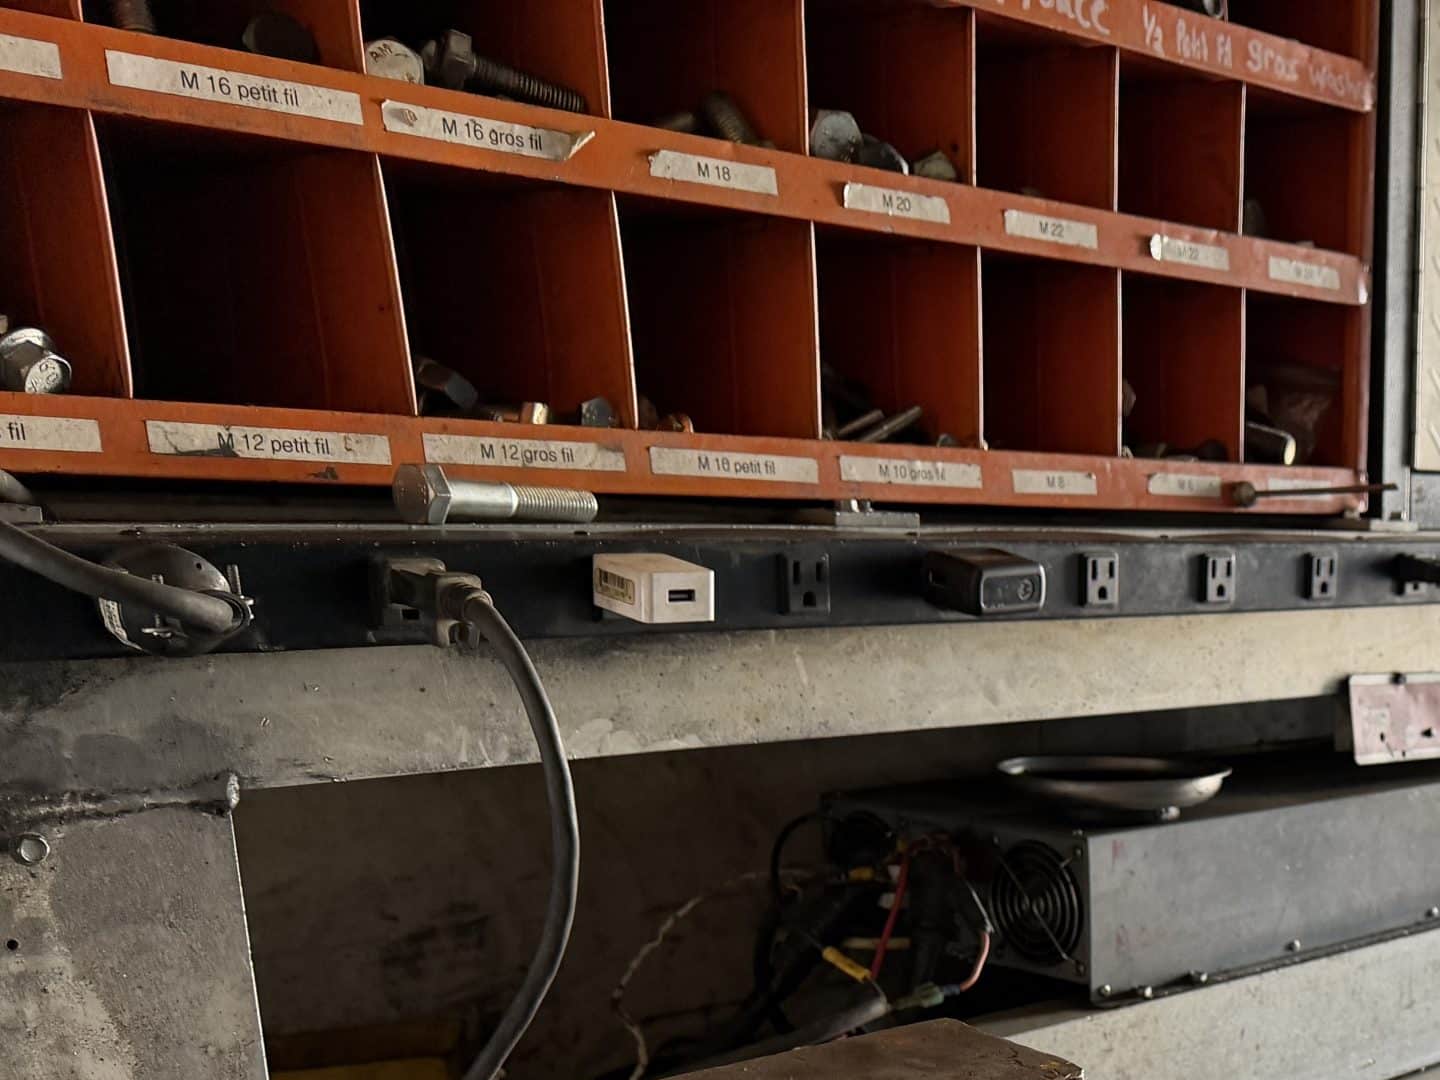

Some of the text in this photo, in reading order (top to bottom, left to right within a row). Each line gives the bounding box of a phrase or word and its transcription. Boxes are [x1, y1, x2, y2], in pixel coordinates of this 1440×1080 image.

[180, 70, 300, 107] M 16 petit fil
[442, 117, 543, 151] M 16 gros fil
[696, 161, 732, 182] M 18
[882, 194, 912, 212] M 20
[6, 421, 26, 441] fil
[217, 431, 331, 456] M 12 petit fil
[480, 443, 575, 464] M 12 gros fil
[697, 455, 711, 471] M
[734, 460, 762, 476] petit
[764, 459, 776, 475] fil
[878, 464, 890, 478] M
[893, 465, 907, 480] 10
